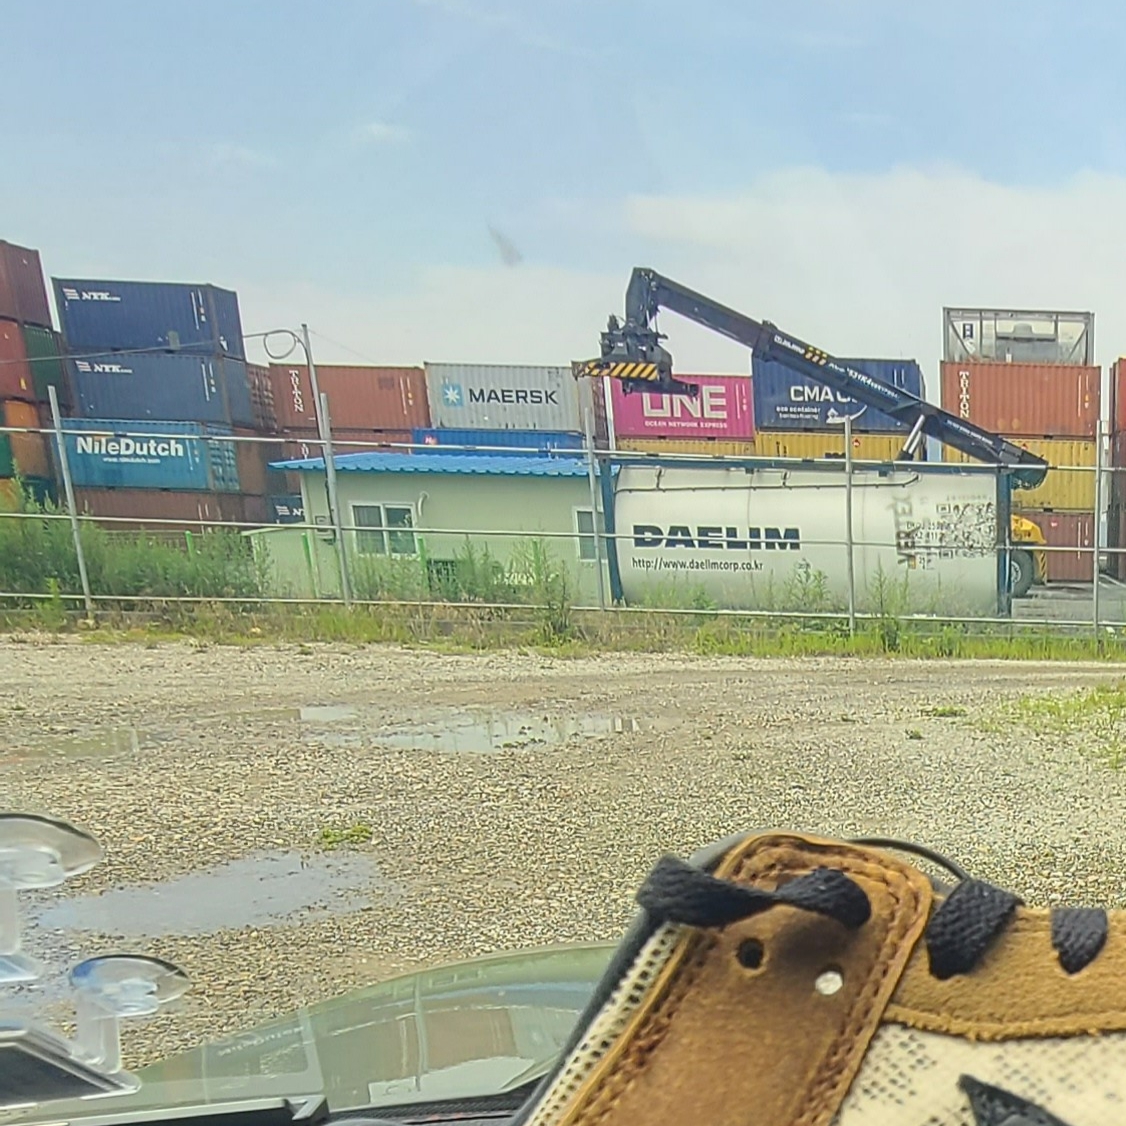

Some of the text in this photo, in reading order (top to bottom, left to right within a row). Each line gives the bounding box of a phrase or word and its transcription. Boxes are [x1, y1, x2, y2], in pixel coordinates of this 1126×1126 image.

[468, 388, 559, 405] MAERSK
[790, 385, 835, 402] CMA
[959, 371, 970, 419] TRITON
[76, 437, 184, 457] NileDutch
[633, 524, 801, 550] DAELIM
